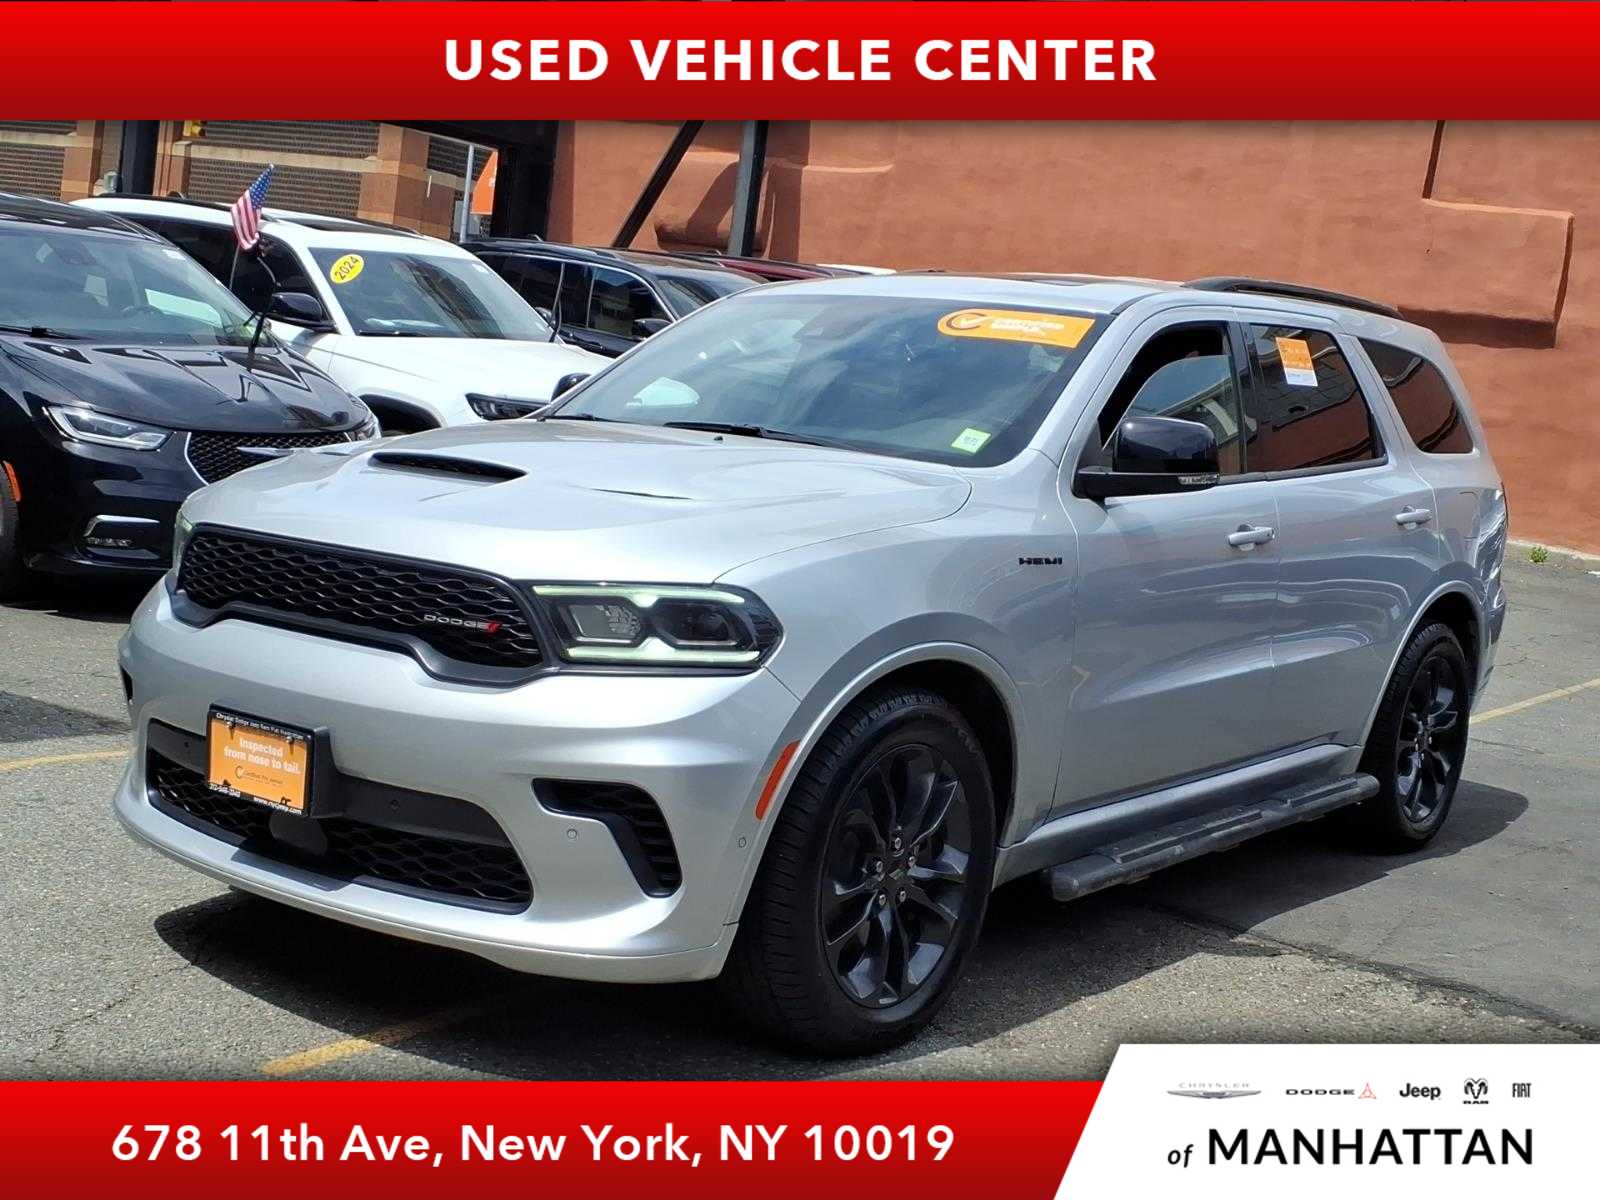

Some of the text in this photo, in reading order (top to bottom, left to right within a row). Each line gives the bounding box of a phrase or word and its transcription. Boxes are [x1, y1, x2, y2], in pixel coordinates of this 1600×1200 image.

[334, 256, 359, 280] 2024
[1018, 557, 1063, 565] HEMI
[424, 614, 488, 630] DODGE
[223, 745, 246, 761] from
[248, 752, 270, 767] nose
[272, 757, 282, 769] to
[239, 737, 283, 757] Inspected
